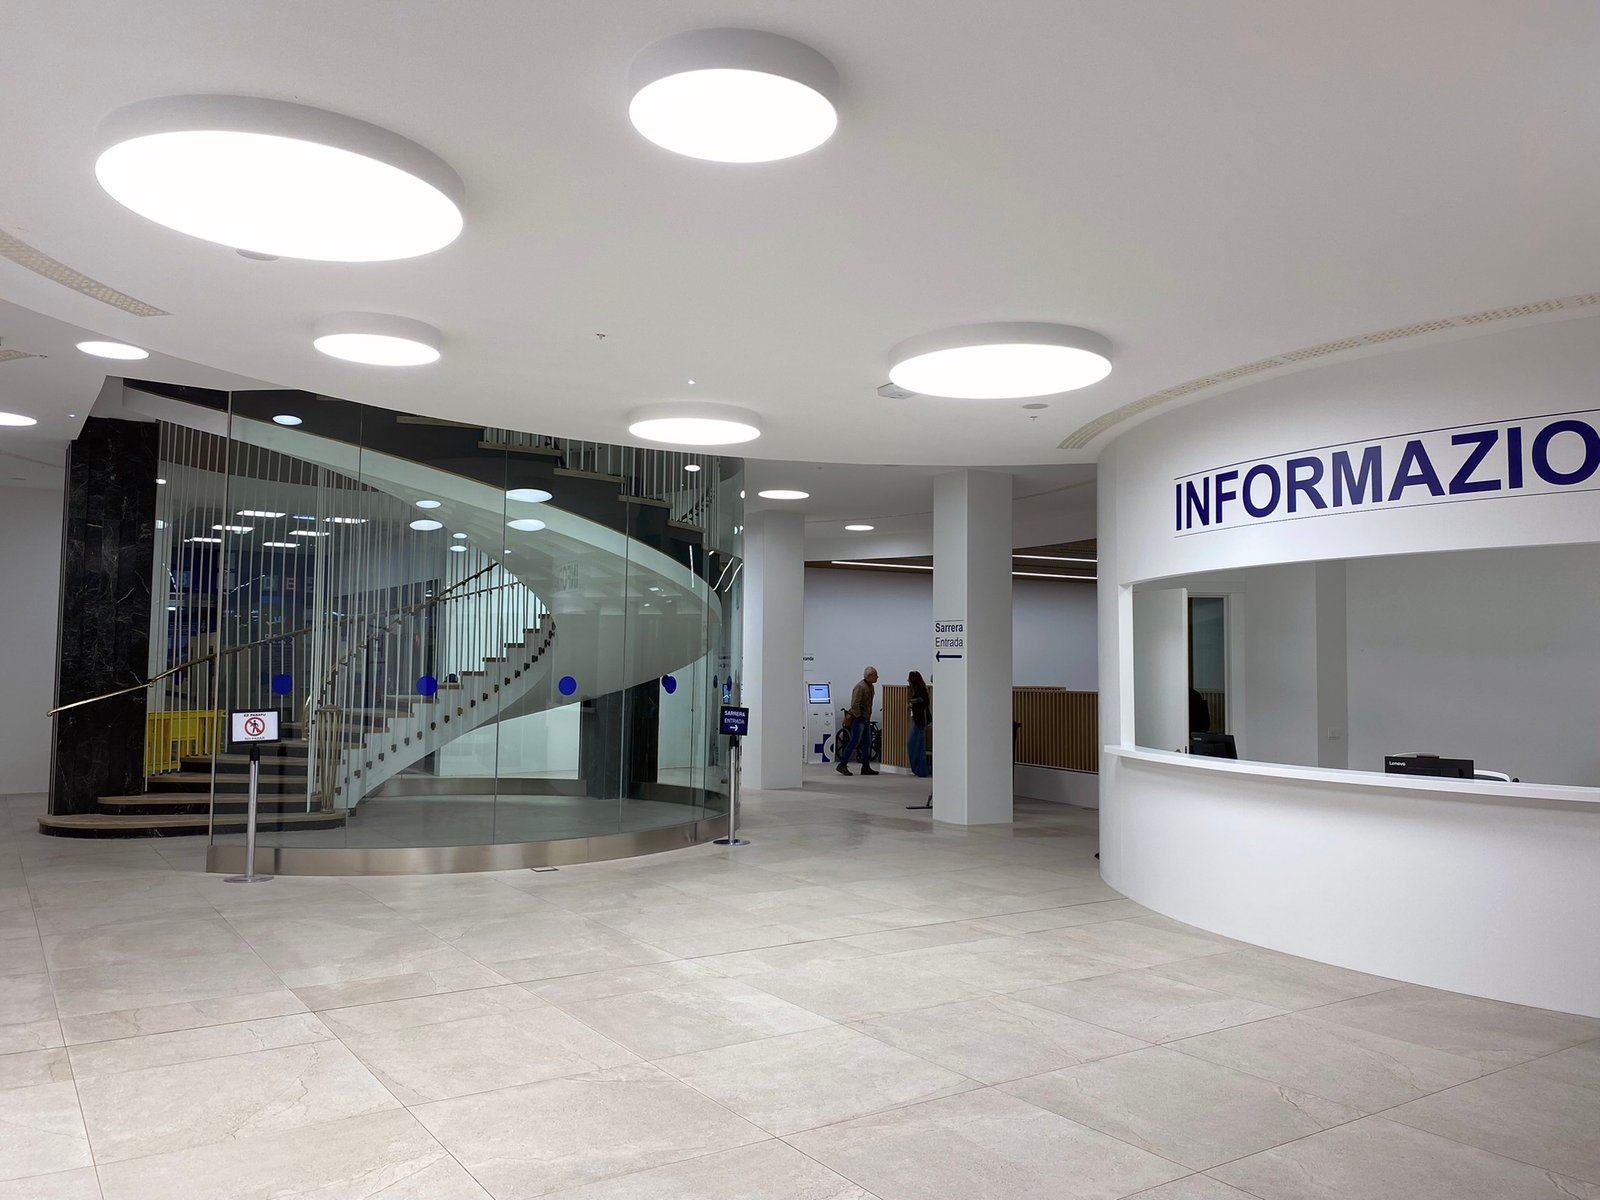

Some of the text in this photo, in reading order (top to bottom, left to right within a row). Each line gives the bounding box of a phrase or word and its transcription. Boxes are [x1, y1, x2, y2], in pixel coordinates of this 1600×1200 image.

[1175, 419, 1600, 531] INFORMAZIO
[935, 622, 963, 633] Sarrera
[935, 637, 963, 647] Entrada
